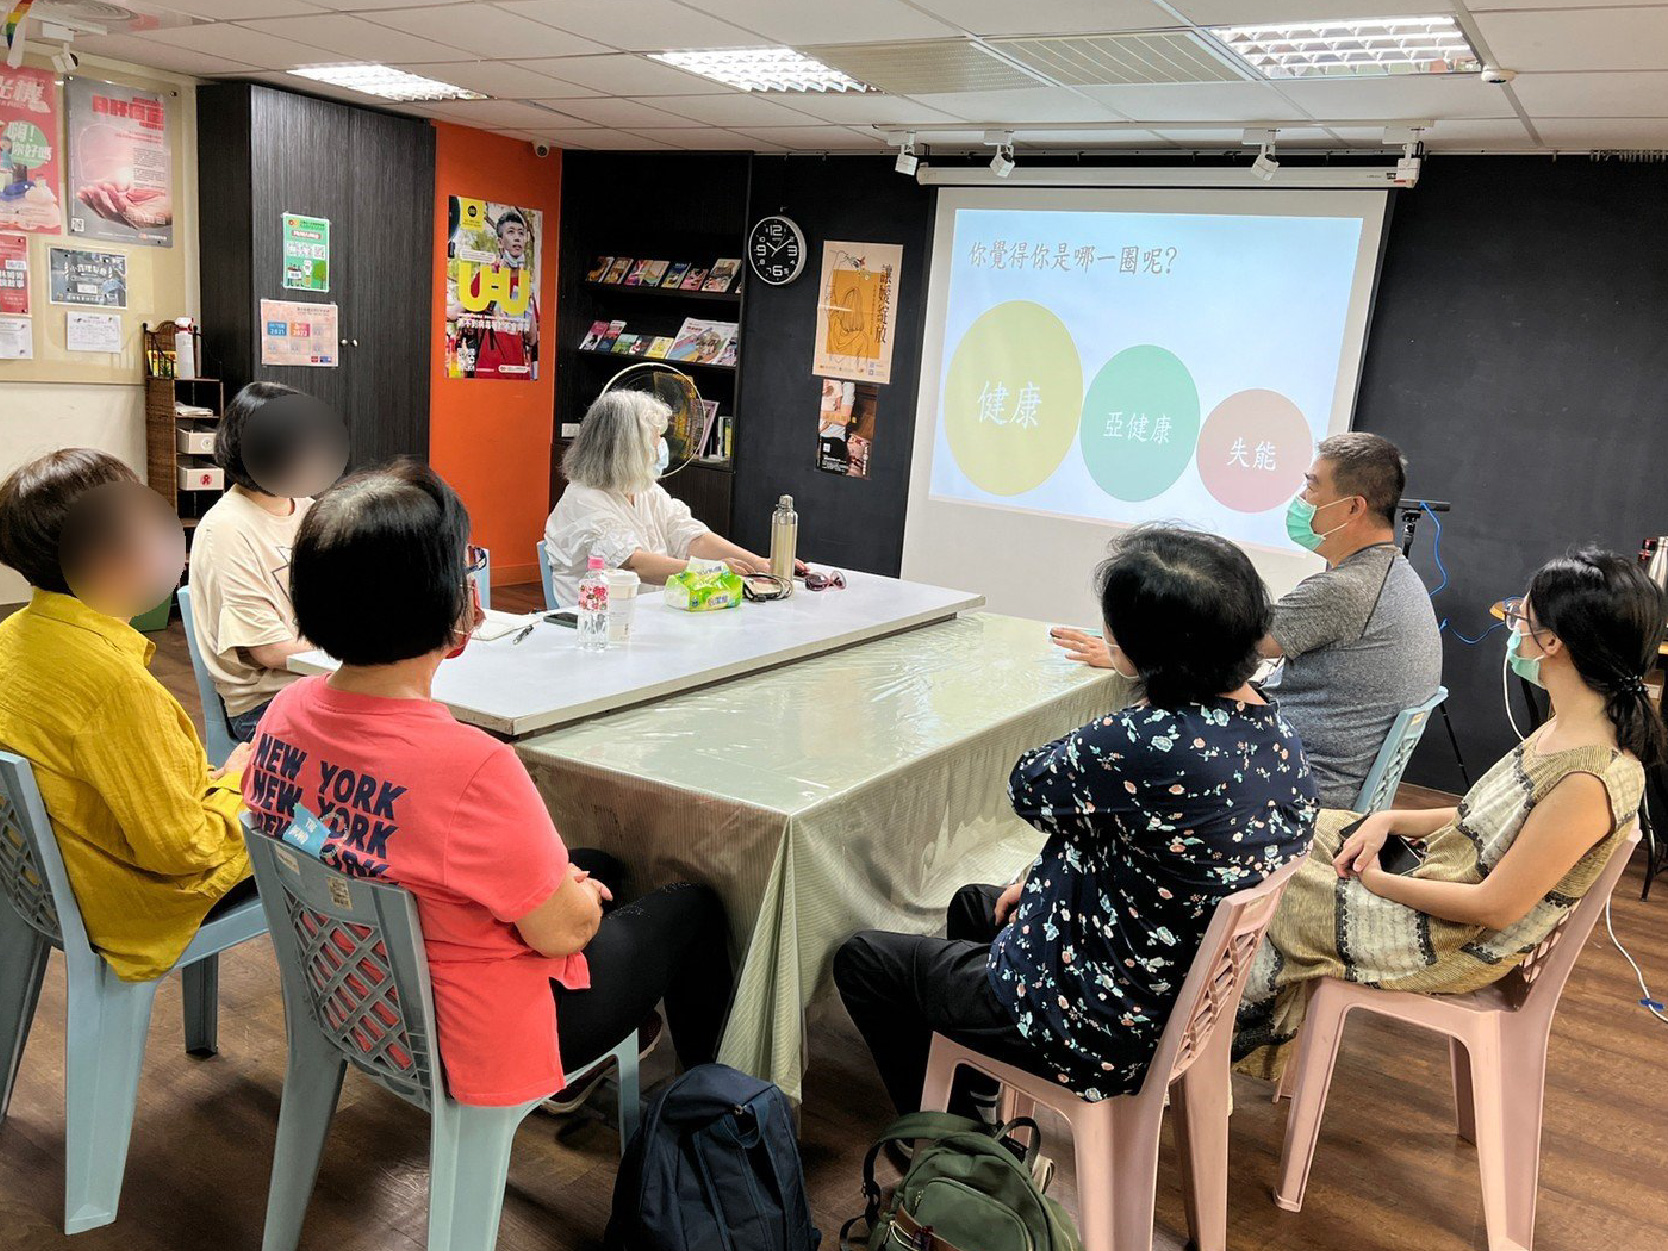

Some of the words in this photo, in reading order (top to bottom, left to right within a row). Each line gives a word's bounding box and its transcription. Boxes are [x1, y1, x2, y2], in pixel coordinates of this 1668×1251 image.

[770, 225, 783, 236] 12
[756, 244, 767, 256] 9
[787, 244, 798, 257] 3
[968, 240, 1178, 275] 你覺得你是哪一圈呢?
[773, 265, 783, 276] 6
[977, 380, 1043, 430] 健康
[1102, 411, 1173, 445] 亞健康
[1226, 436, 1277, 472] 失能
[254, 733, 307, 781] NEW
[318, 760, 408, 821] YORK
[252, 769, 303, 818] NEW
[317, 795, 399, 860] YORK
[319, 843, 390, 878] ORK
